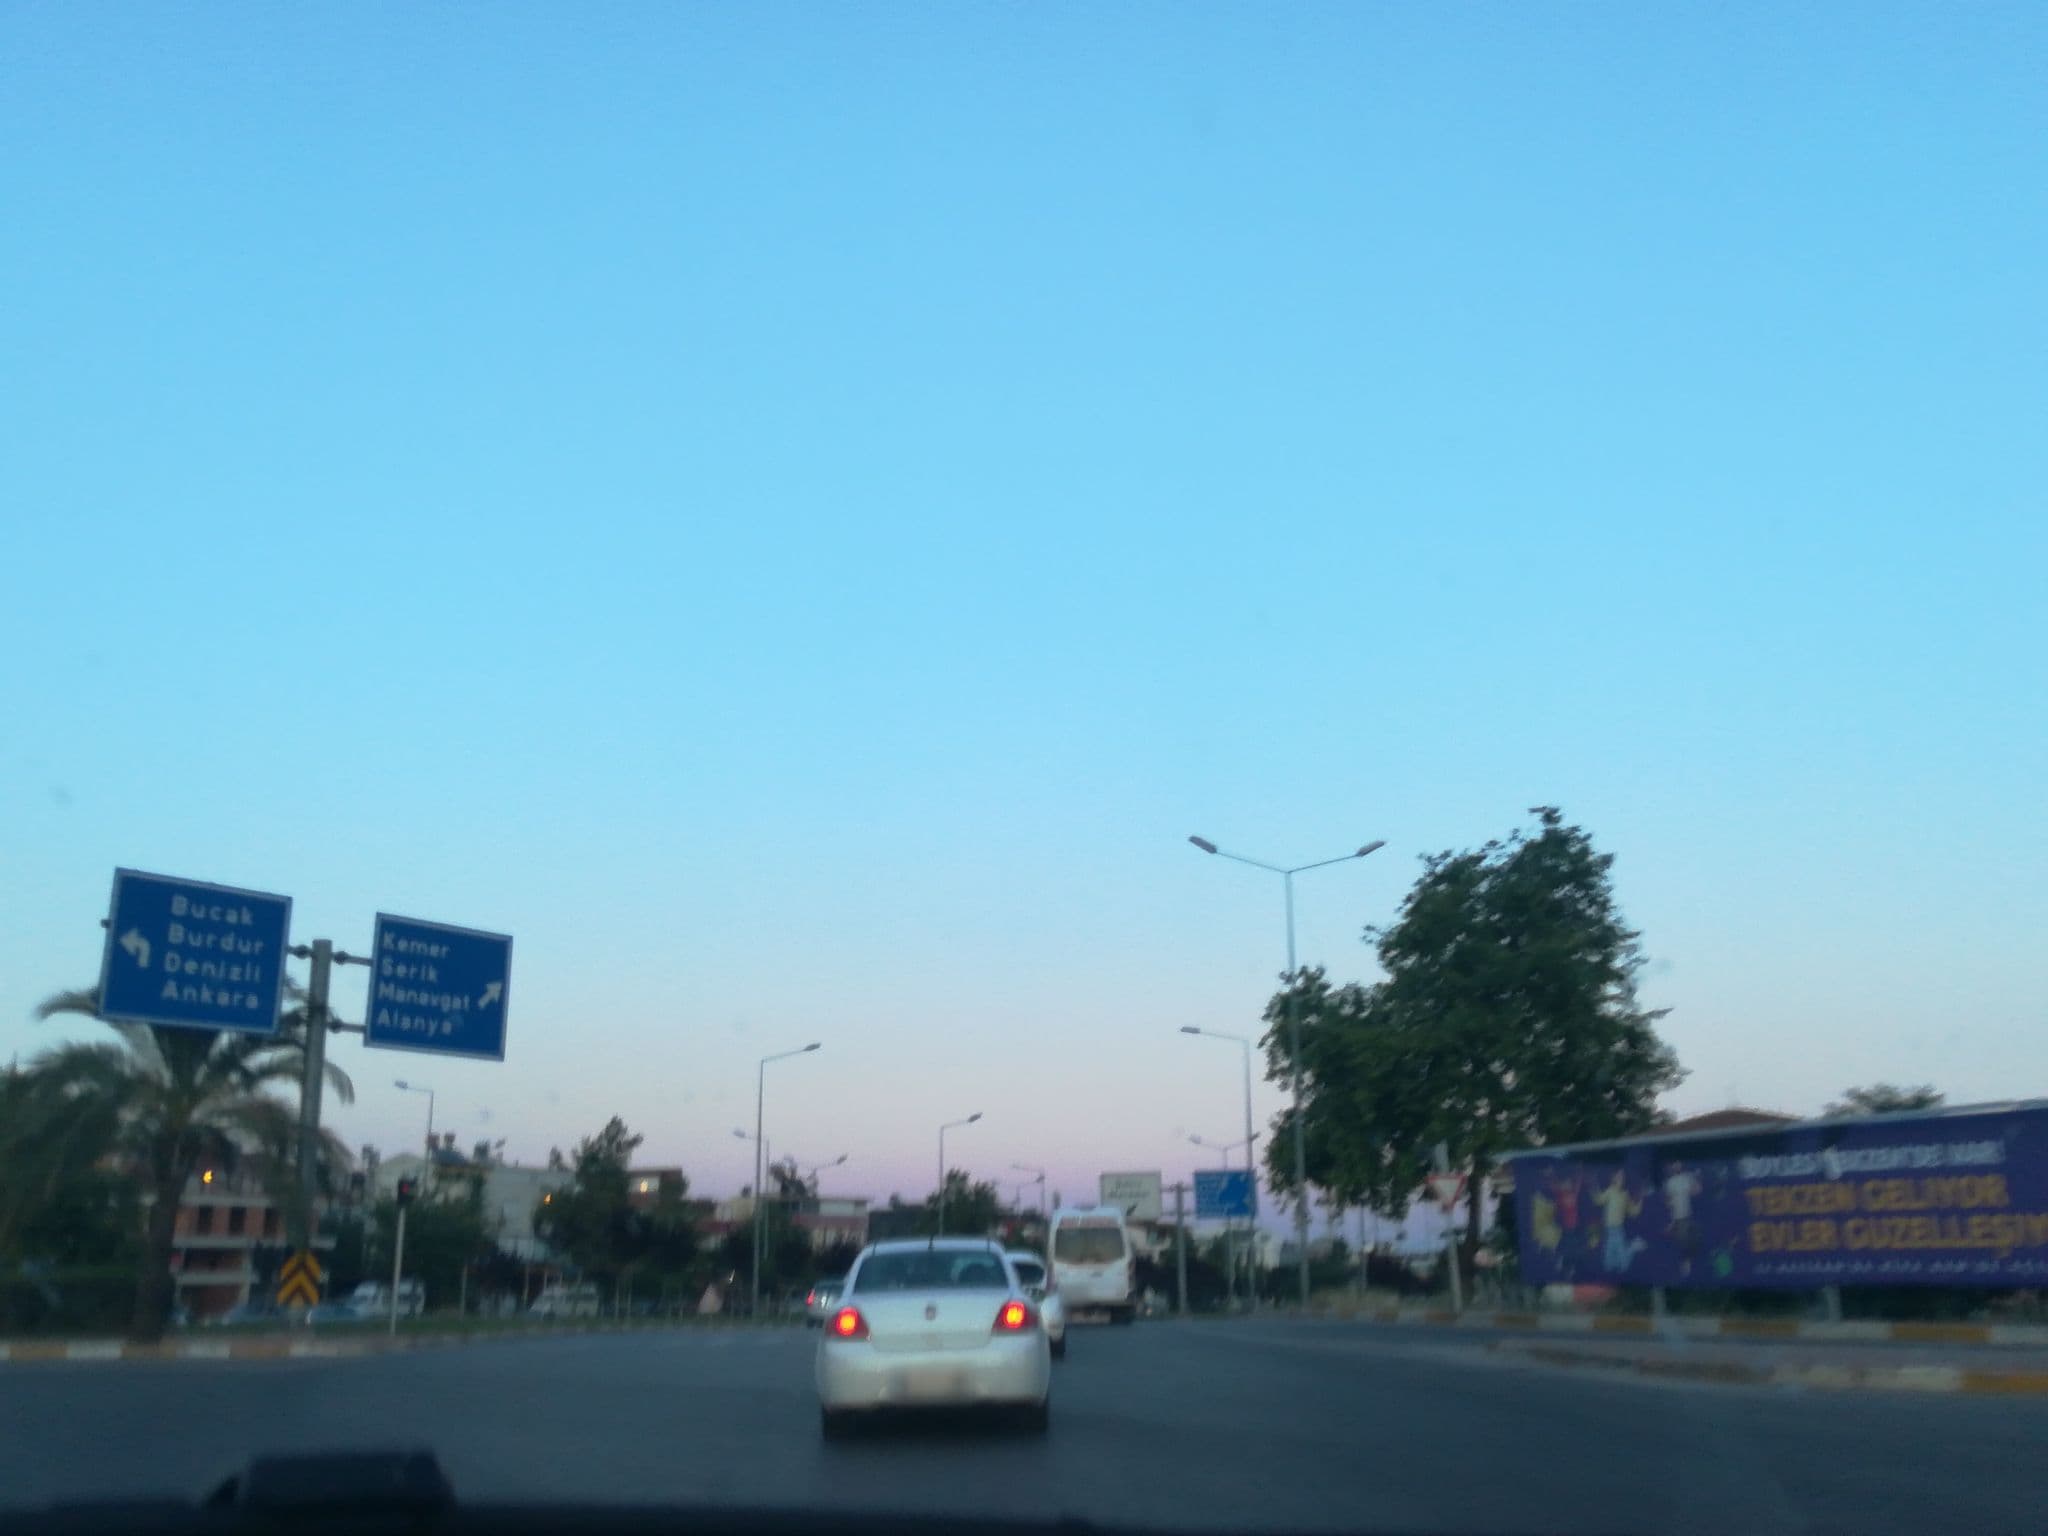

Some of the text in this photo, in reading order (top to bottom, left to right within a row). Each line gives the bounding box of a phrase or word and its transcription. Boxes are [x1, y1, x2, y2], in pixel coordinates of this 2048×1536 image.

[171, 894, 254, 926] Bucak
[168, 922, 265, 955] Burdur
[383, 931, 450, 959] Kemer
[164, 951, 262, 983] Denizli
[382, 956, 439, 983] Serik
[161, 979, 259, 1010] Ankara
[379, 980, 471, 1012] Manavgat
[377, 1008, 453, 1037] Alanya
